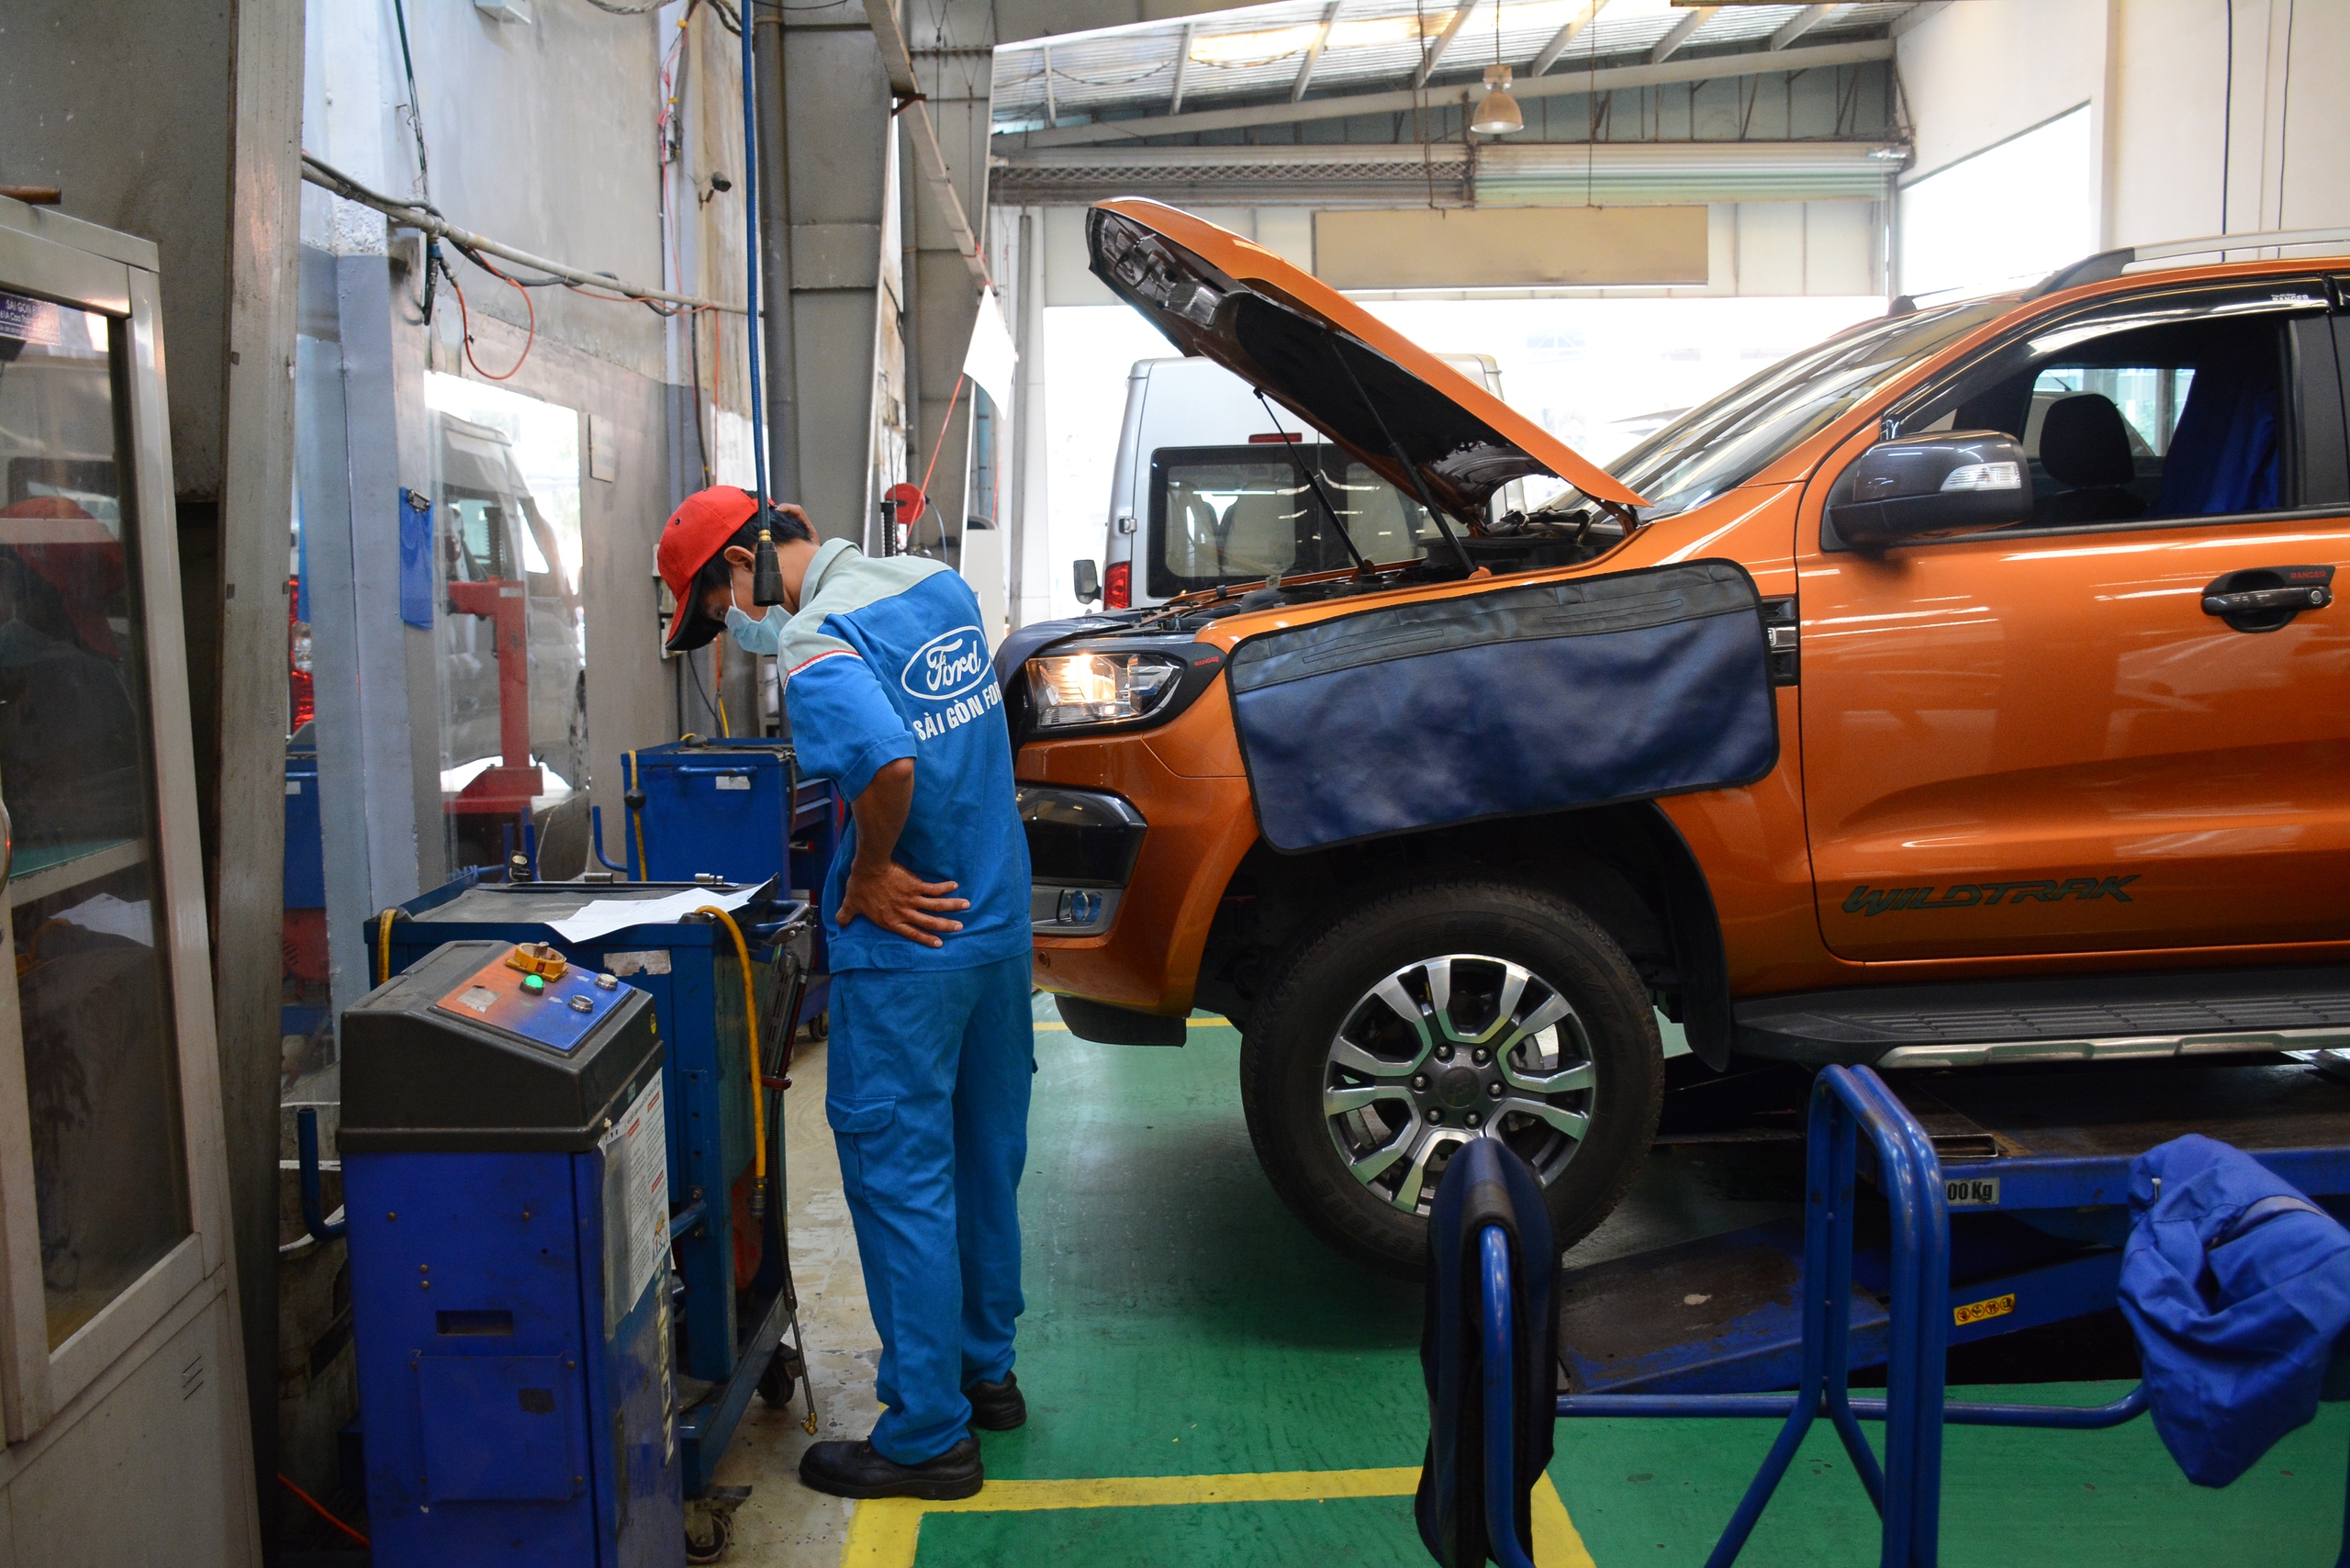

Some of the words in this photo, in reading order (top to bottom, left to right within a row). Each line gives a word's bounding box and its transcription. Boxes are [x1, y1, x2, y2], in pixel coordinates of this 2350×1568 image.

[2290, 570, 2327, 579] RANGER
[926, 638, 981, 691] Ford
[912, 711, 946, 741] SÀI
[946, 695, 985, 729] GÒN
[982, 680, 1002, 710] FOR
[1841, 875, 2143, 917] WILDTRAK
[1945, 1182, 1969, 1201] 00
[1971, 1181, 1993, 1201] Kg
